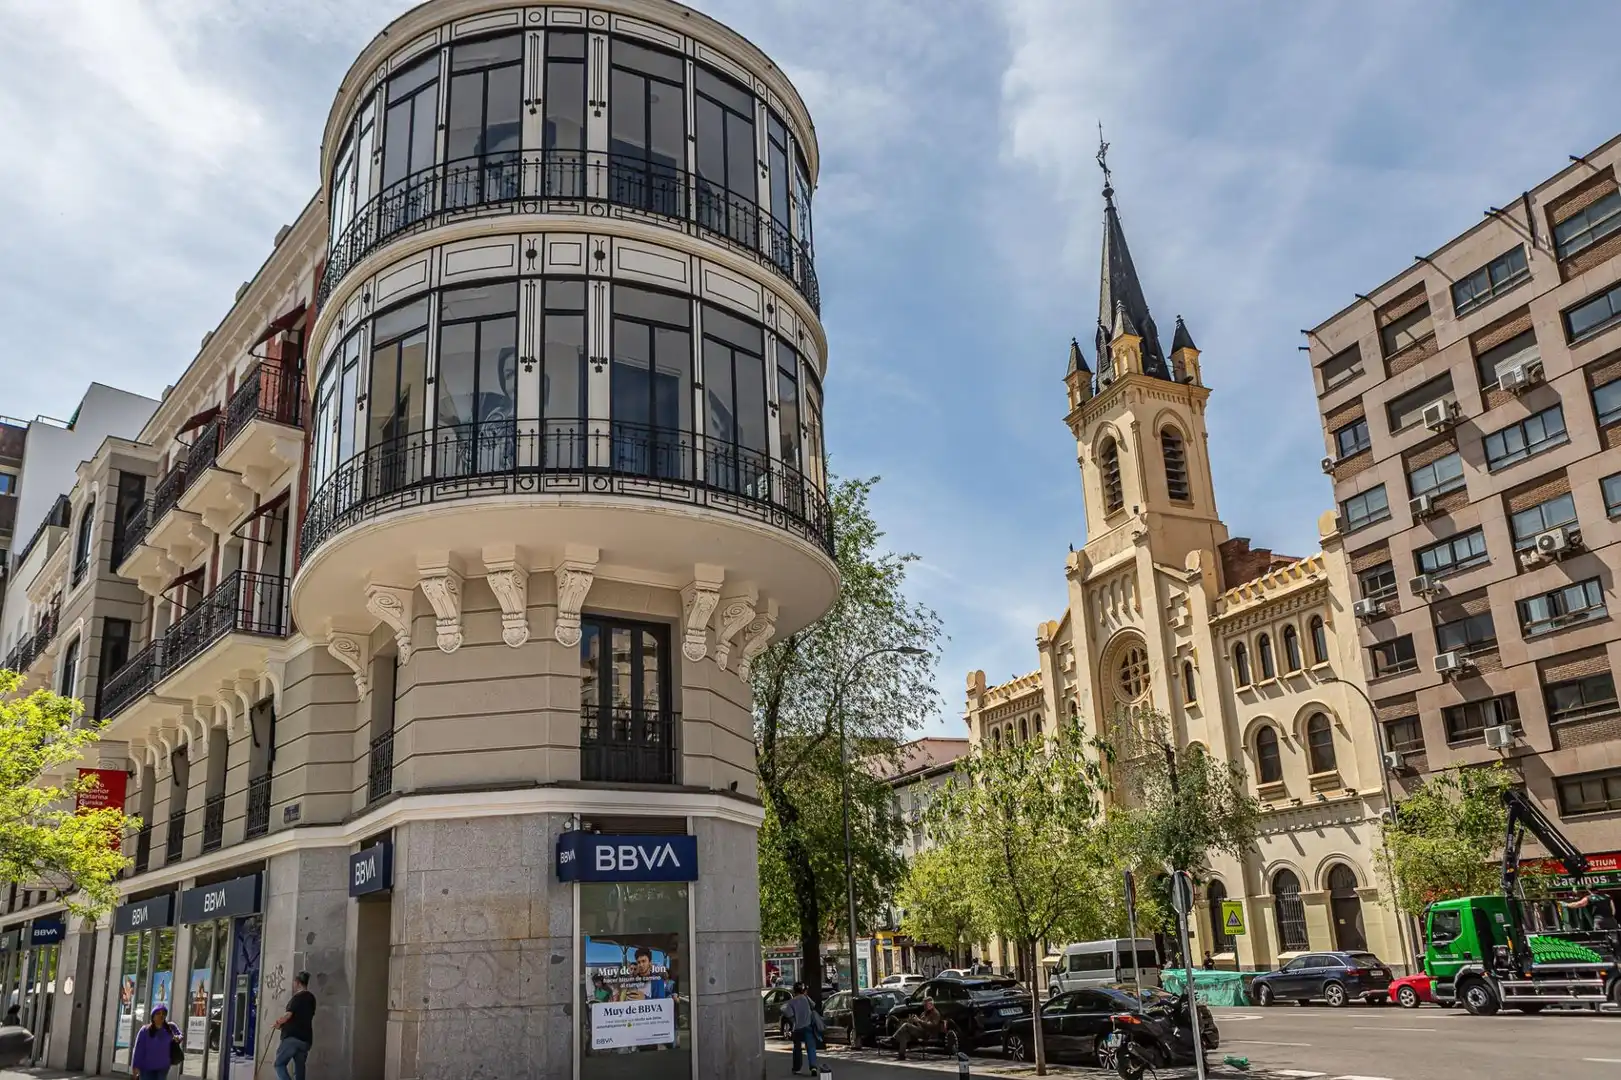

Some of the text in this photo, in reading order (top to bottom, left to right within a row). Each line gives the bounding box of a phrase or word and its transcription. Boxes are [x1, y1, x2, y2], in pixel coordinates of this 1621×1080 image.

[560, 849, 576, 864] BBVA
[596, 842, 680, 871] BBVA
[355, 855, 376, 886] BBVA
[203, 887, 226, 913] BBVA
[131, 905, 148, 926] BBVA
[33, 928, 58, 936] BBVA
[597, 966, 619, 977] Muy
[603, 1004, 663, 1017] Muy de BBVA
[596, 1037, 614, 1045] BBVA
